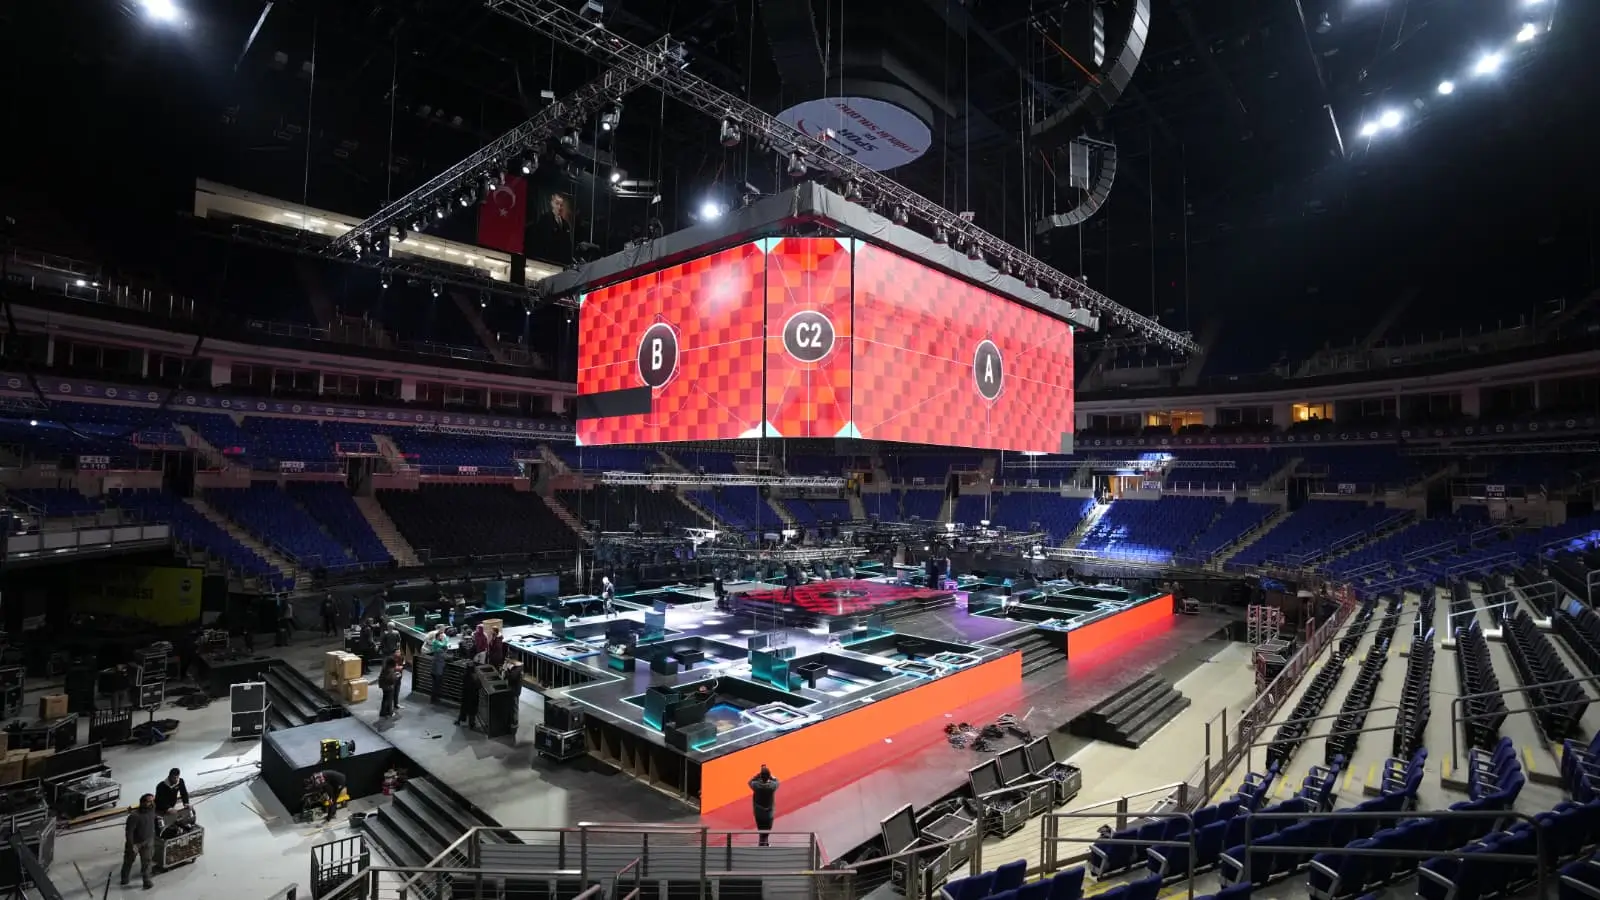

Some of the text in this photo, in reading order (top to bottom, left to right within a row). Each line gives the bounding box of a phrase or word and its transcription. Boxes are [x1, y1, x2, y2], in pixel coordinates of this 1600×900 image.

[837, 129, 879, 151] SPOR
[796, 322, 822, 348] C2
[652, 339, 663, 370] B
[984, 358, 994, 384] A
